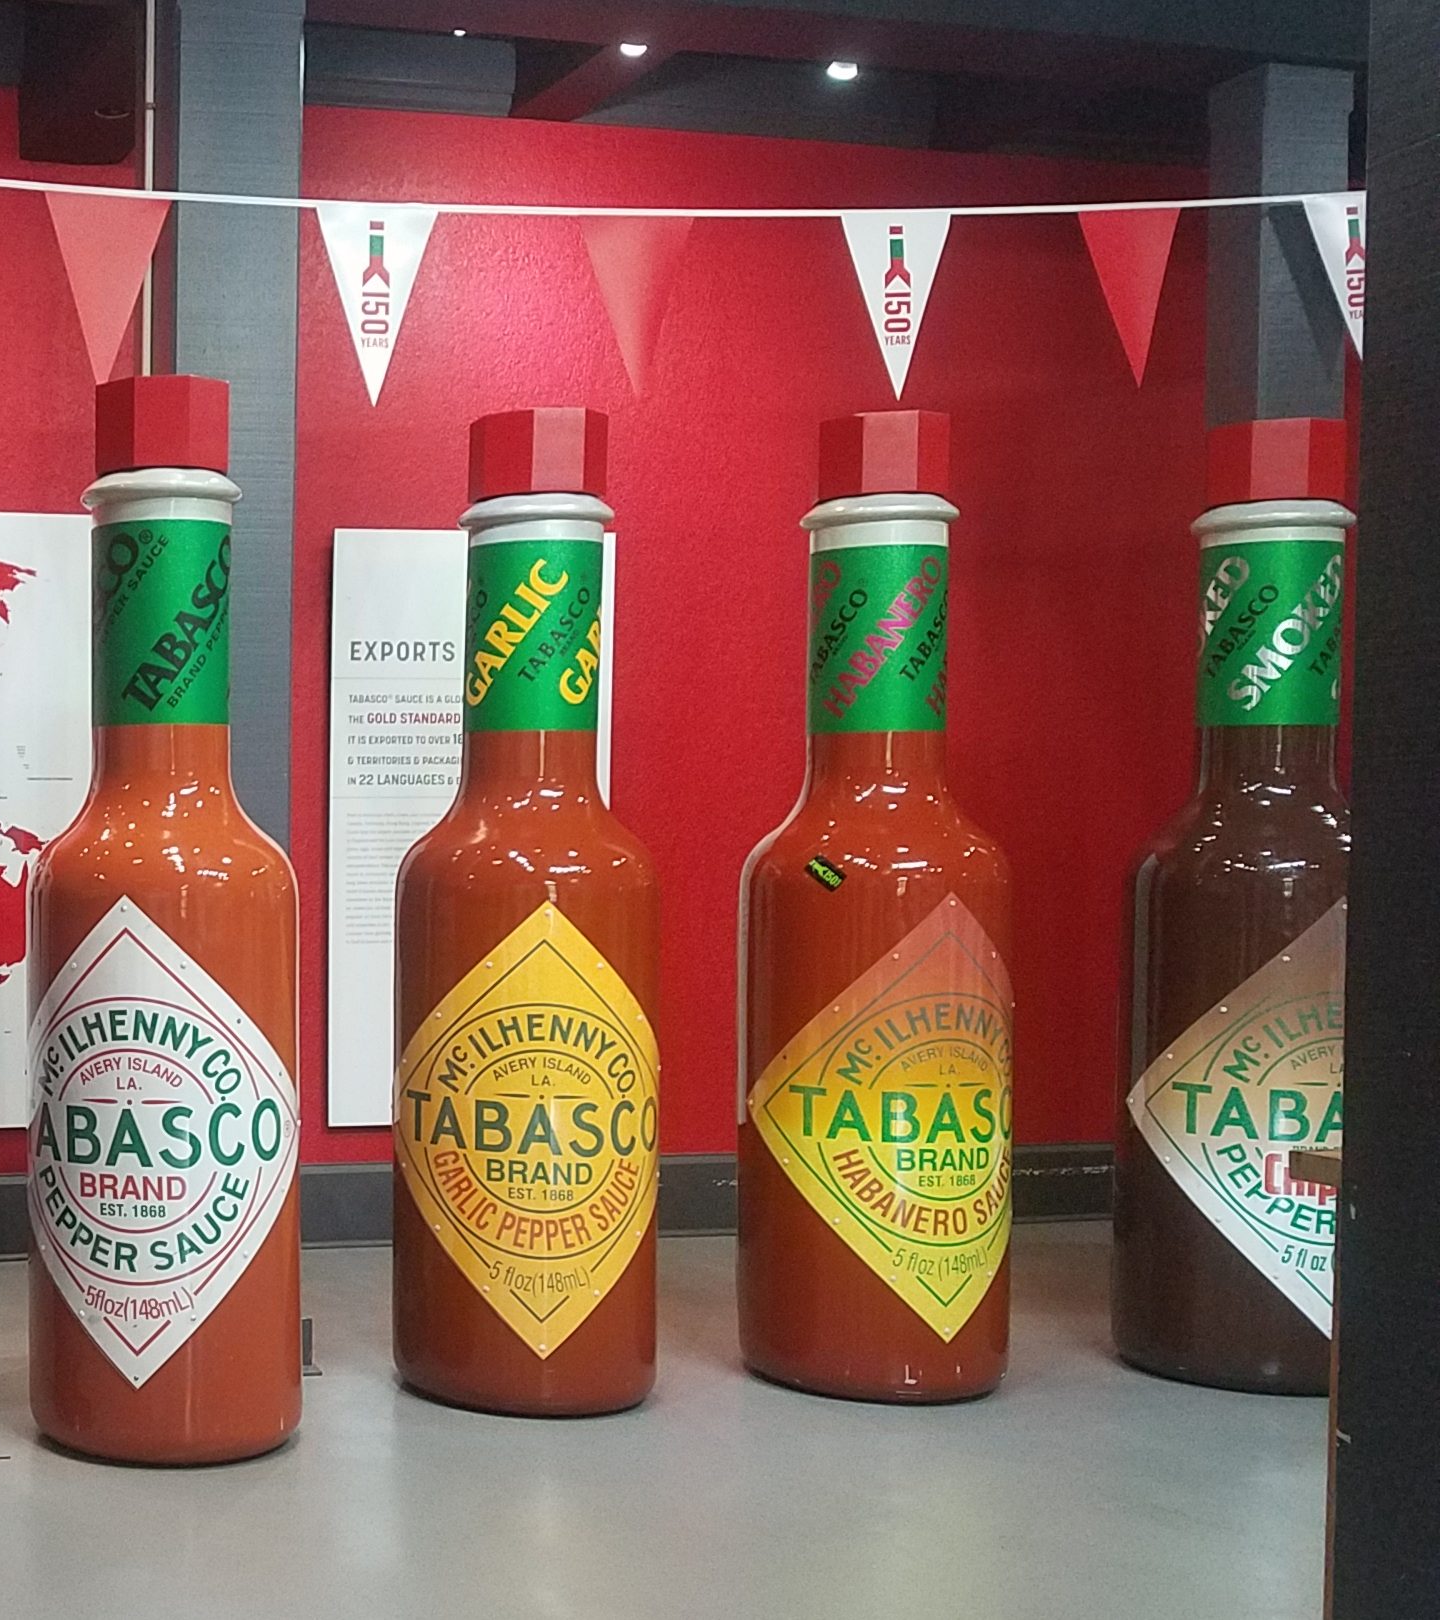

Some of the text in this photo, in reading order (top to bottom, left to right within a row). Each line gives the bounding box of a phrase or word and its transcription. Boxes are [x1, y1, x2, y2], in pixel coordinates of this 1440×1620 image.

[361, 292, 390, 335] 150
[884, 291, 911, 333] 150
[361, 337, 389, 348] YEARS
[884, 335, 911, 346] YEARS
[128, 535, 169, 591] SAUCE
[466, 558, 569, 706] GARLIC
[518, 587, 591, 682] TABASCO
[823, 556, 942, 719] HABANERO
[1205, 584, 1279, 678] TABASCO
[350, 641, 456, 662] EXPORTS
[167, 654, 207, 708] BRAND
[395, 694, 423, 704] SAUCE
[425, 695, 434, 704] IS
[436, 695, 442, 704] A
[348, 712, 461, 725] THE GOLD STANDARD
[348, 735, 450, 745] IT IS EXPORTED TO OVER
[356, 756, 411, 765] TERRITORIES
[347, 776, 357, 785] IN
[359, 774, 374, 785] 22
[377, 774, 445, 785] LANGUAGES
[492, 1056, 592, 1085] AVERY ISLAND
[901, 1047, 988, 1072] AVERY ISLAND
[1290, 1045, 1336, 1070] AVERY
[80, 1057, 183, 1088] AVERY ISLAND
[407, 1089, 657, 1158] TABASCO
[486, 1158, 593, 1185] BRAND
[897, 1147, 989, 1171] BRAND
[79, 1172, 187, 1201] BRAND
[508, 1187, 574, 1201] EST. 1868
[833, 1149, 967, 1236] HABANERO
[919, 1174, 976, 1188] EST. 1868
[100, 1203, 166, 1218] EST. 1868
[433, 1150, 640, 1251] GARLIC PEPPER SAUCE
[39, 1164, 250, 1273] PEPPER SAUCE
[1281, 1245, 1294, 1263] 5
[1296, 1248, 1307, 1268] fl
[1311, 1255, 1326, 1272] oz
